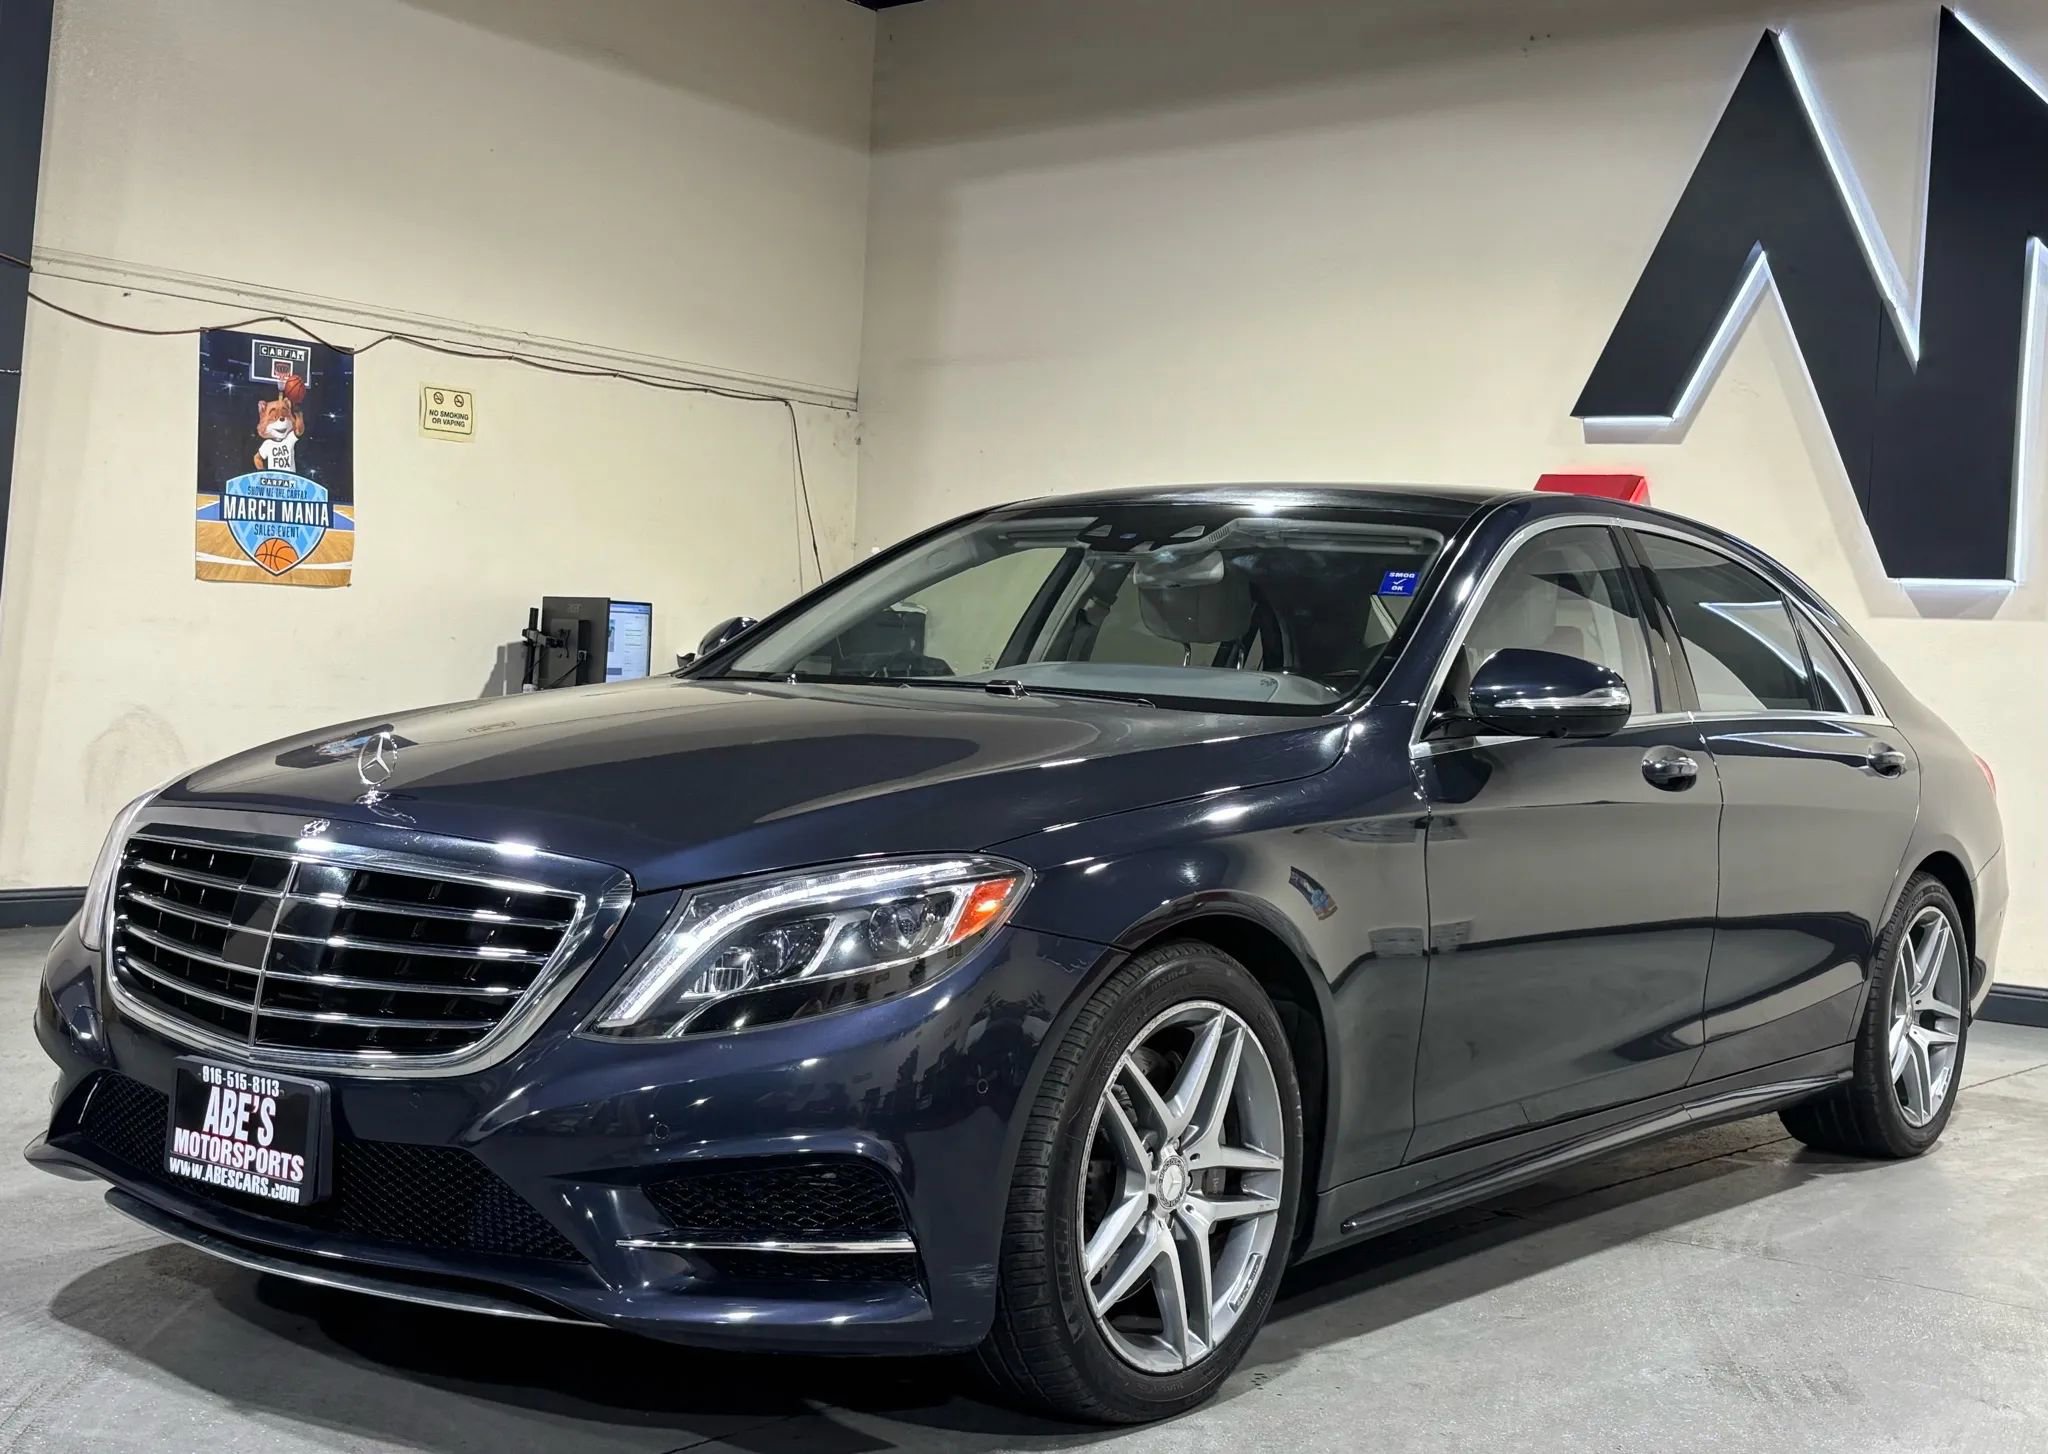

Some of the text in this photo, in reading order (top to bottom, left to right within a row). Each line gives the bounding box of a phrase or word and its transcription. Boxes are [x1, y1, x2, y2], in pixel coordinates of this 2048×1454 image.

[260, 345, 305, 361] CARFAX
[440, 410, 469, 420] SMOKING
[443, 418, 465, 427] VAPING
[272, 445, 289, 456] CAR
[273, 455, 290, 468] FOX
[260, 478, 297, 489] CARFAX
[223, 494, 330, 527] MARCH MANIA
[253, 523, 300, 538] SALES EVENT
[202, 1065, 280, 1097] 916-515-8113
[202, 1085, 277, 1146] ABE'S
[173, 1127, 305, 1182] MOTORSPORTS
